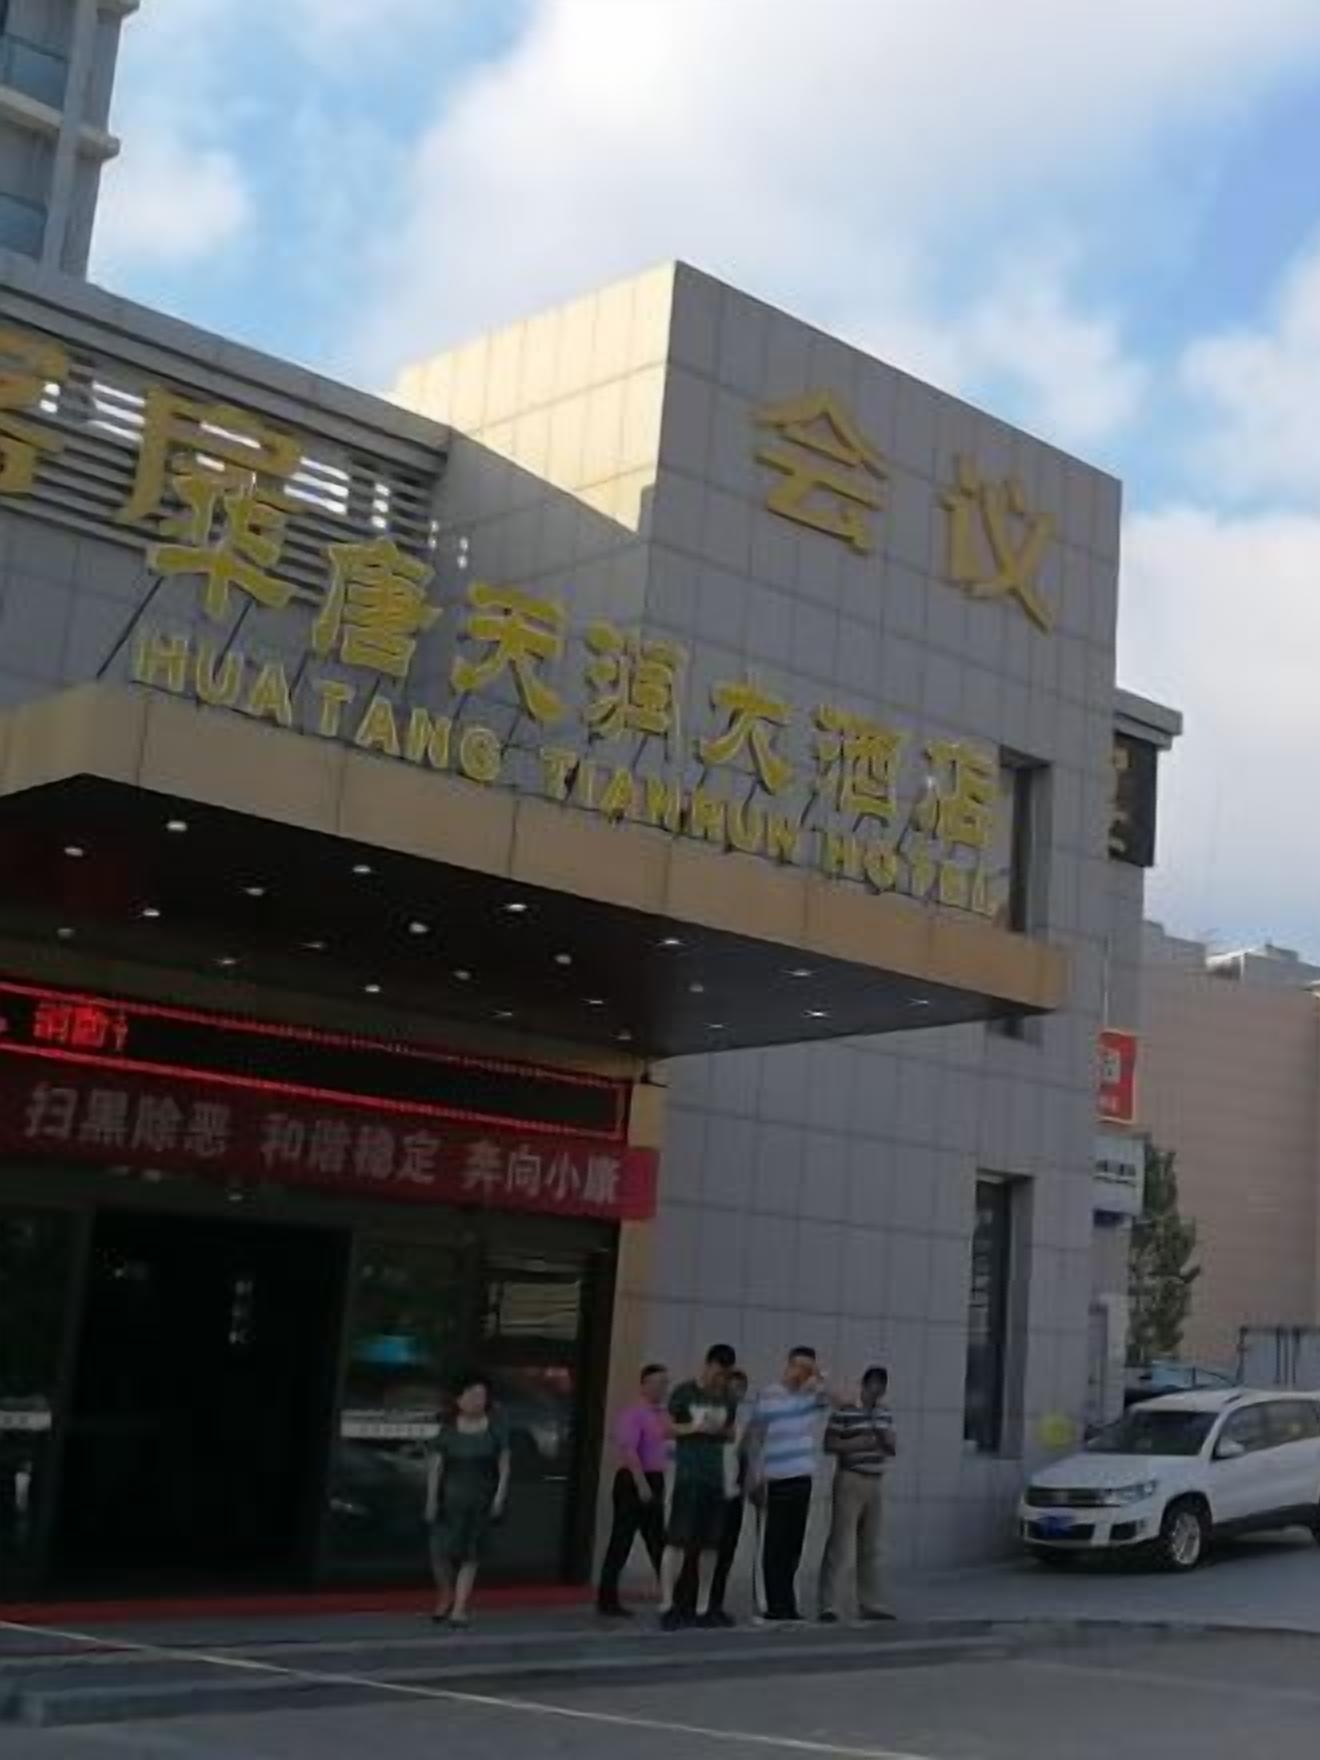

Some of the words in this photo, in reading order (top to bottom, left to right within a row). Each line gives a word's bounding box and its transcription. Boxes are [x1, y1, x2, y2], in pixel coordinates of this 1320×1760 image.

[751, 388, 1058, 634] 会议
[132, 632, 293, 727] HUA
[313, 677, 503, 783] TANG
[822, 824, 998, 918] HOTEL
[24, 1079, 232, 1158] 扫黑除恶
[257, 1111, 440, 1186] 和谐稳定
[460, 1136, 623, 1206] 奔向小康
